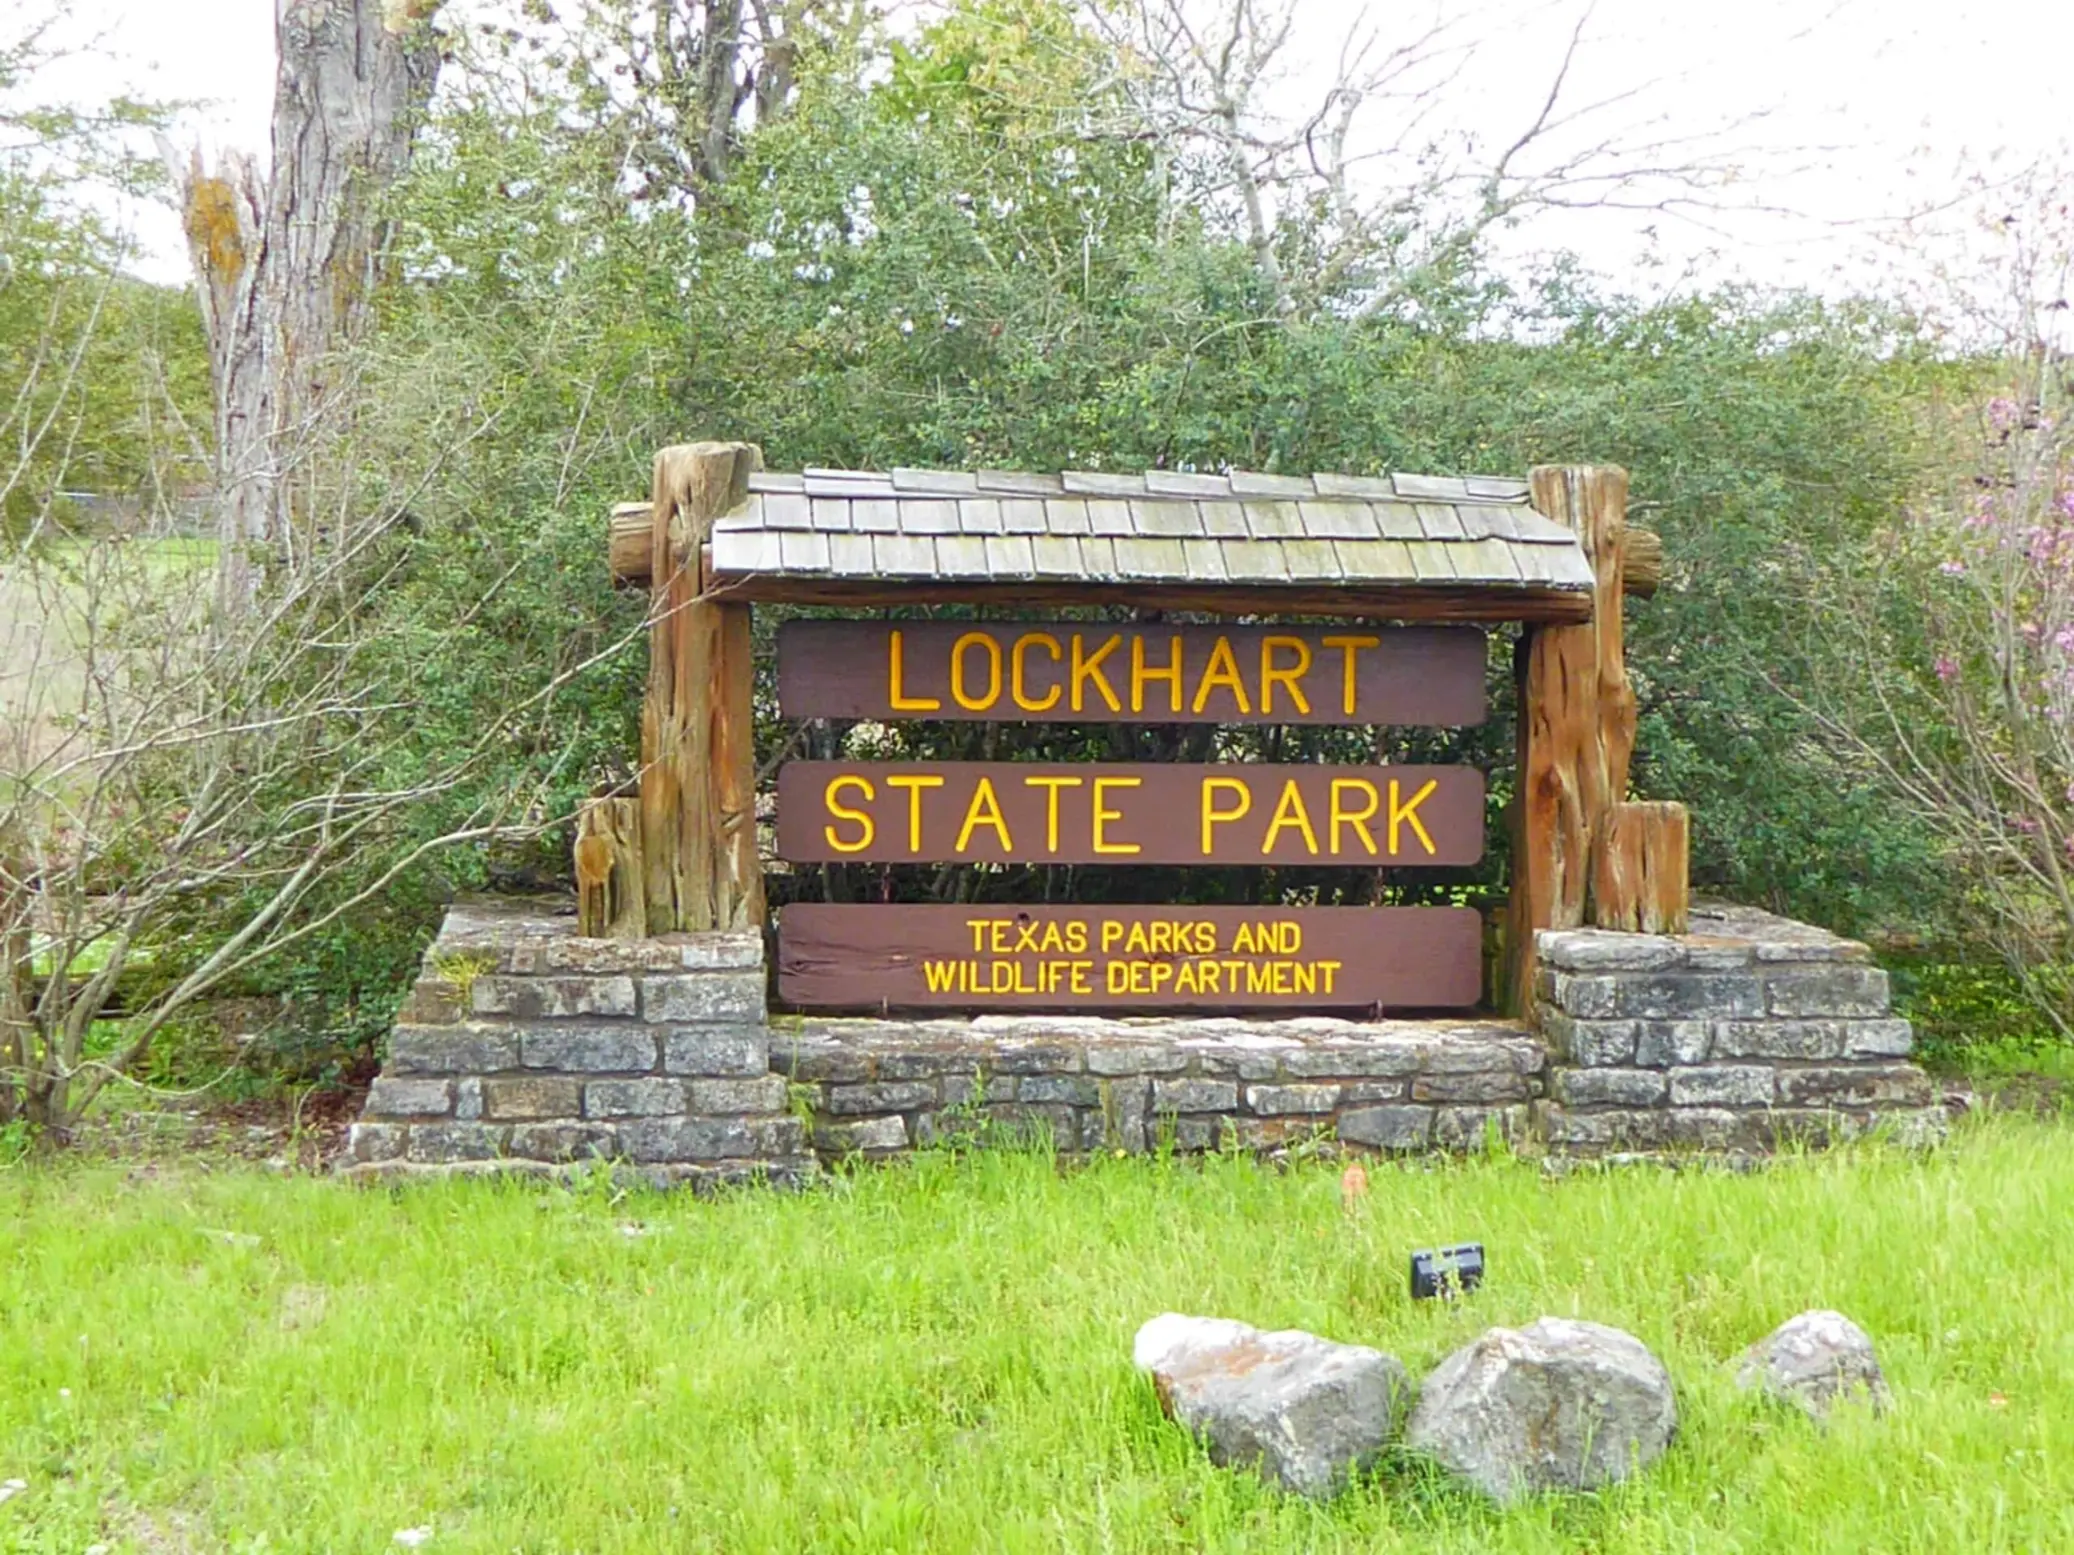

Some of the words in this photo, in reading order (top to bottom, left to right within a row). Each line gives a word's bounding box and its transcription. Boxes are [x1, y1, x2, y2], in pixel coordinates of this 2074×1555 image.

[888, 630, 1381, 716] LOCKHART
[823, 773, 1144, 855] STATE
[1200, 776, 1439, 857] PARK
[966, 919, 1088, 954] TEXAS
[1101, 920, 1217, 954] PARKS
[1232, 920, 1302, 955] AND
[922, 960, 1094, 994] WILDLIFE
[1105, 960, 1342, 995] DEPARTMENT
